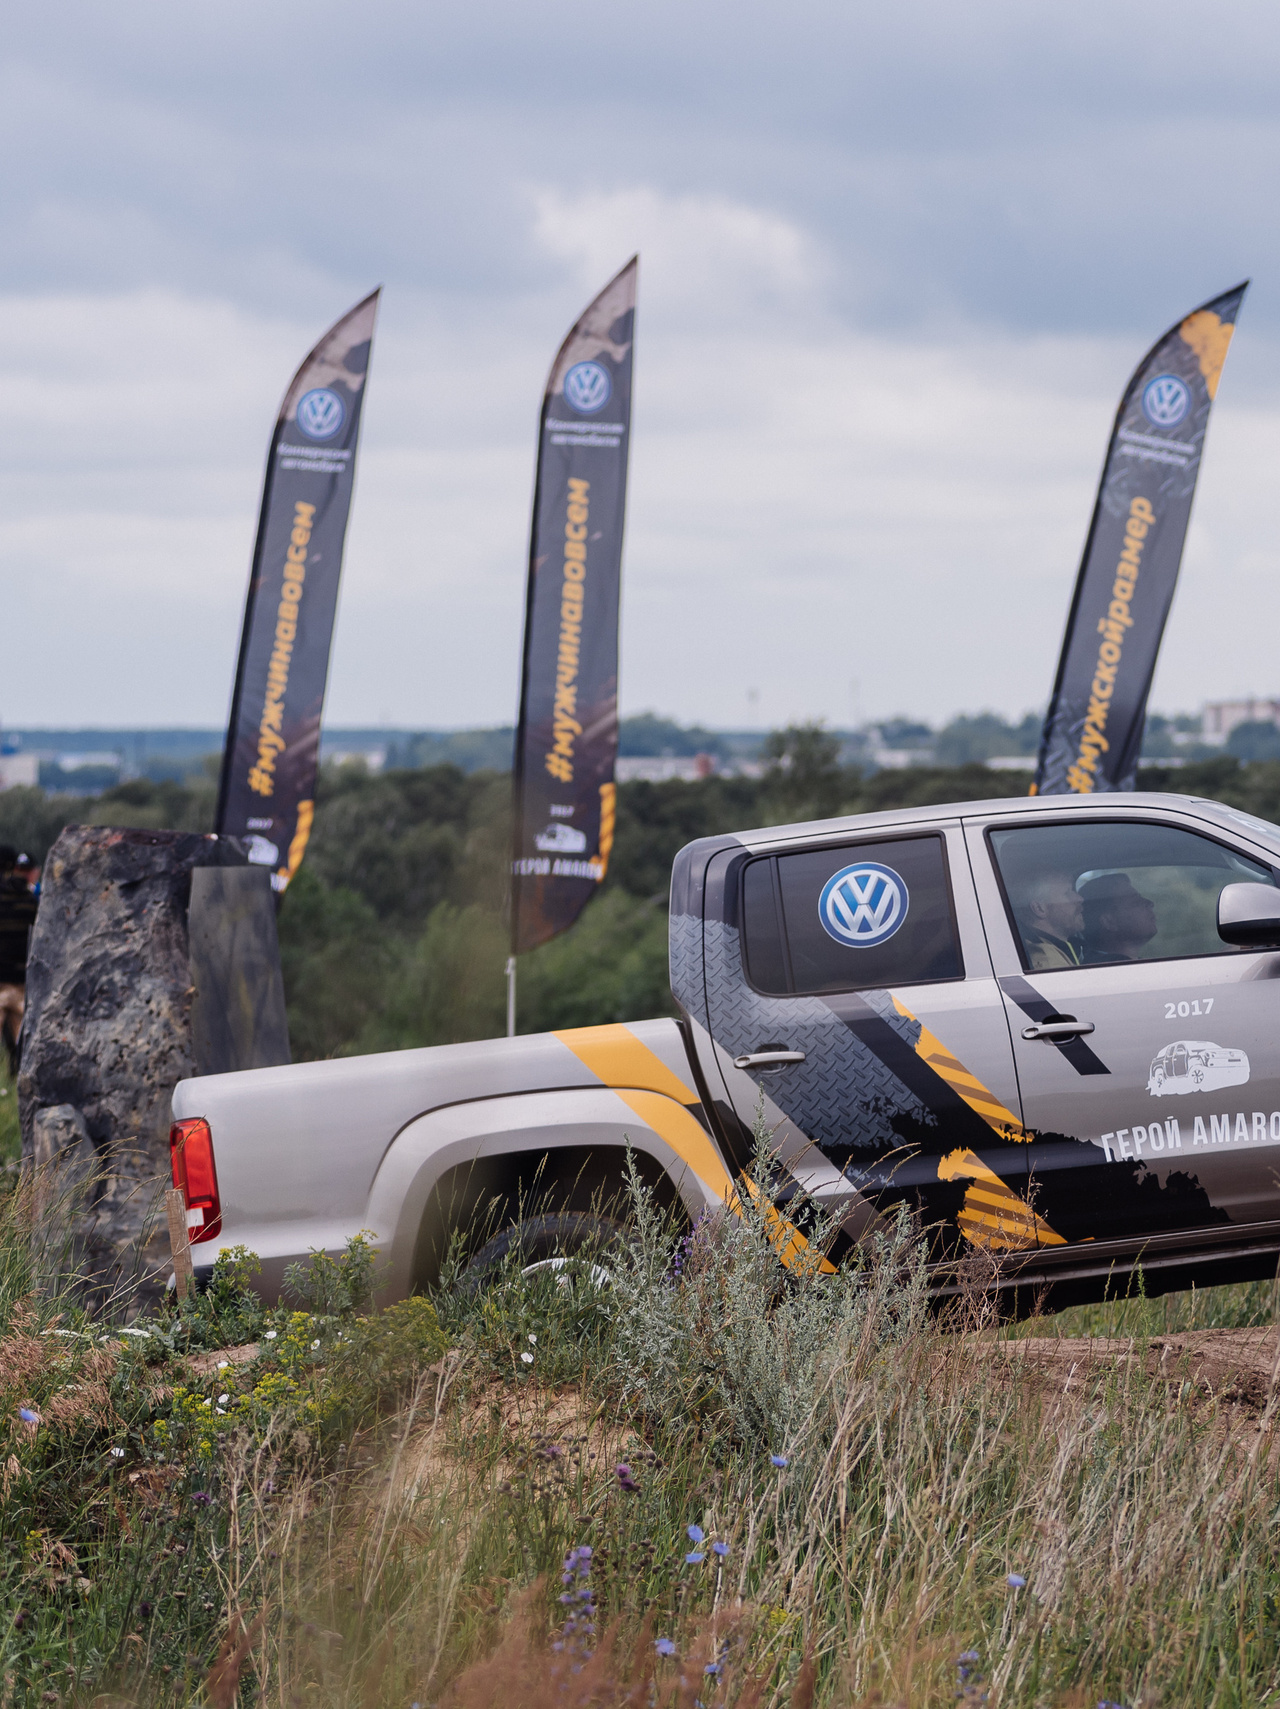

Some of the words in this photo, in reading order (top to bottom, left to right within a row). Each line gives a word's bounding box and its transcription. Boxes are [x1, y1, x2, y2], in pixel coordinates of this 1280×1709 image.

[567, 364, 608, 410] VW
[1146, 378, 1188, 425] VW
[300, 391, 342, 437] VW
[1066, 496, 1156, 794] #мужскойразмер
[825, 869, 901, 941] VW
[1164, 998, 1214, 1019] 2017
[1101, 1116, 1182, 1163] ГЕРОЙ
